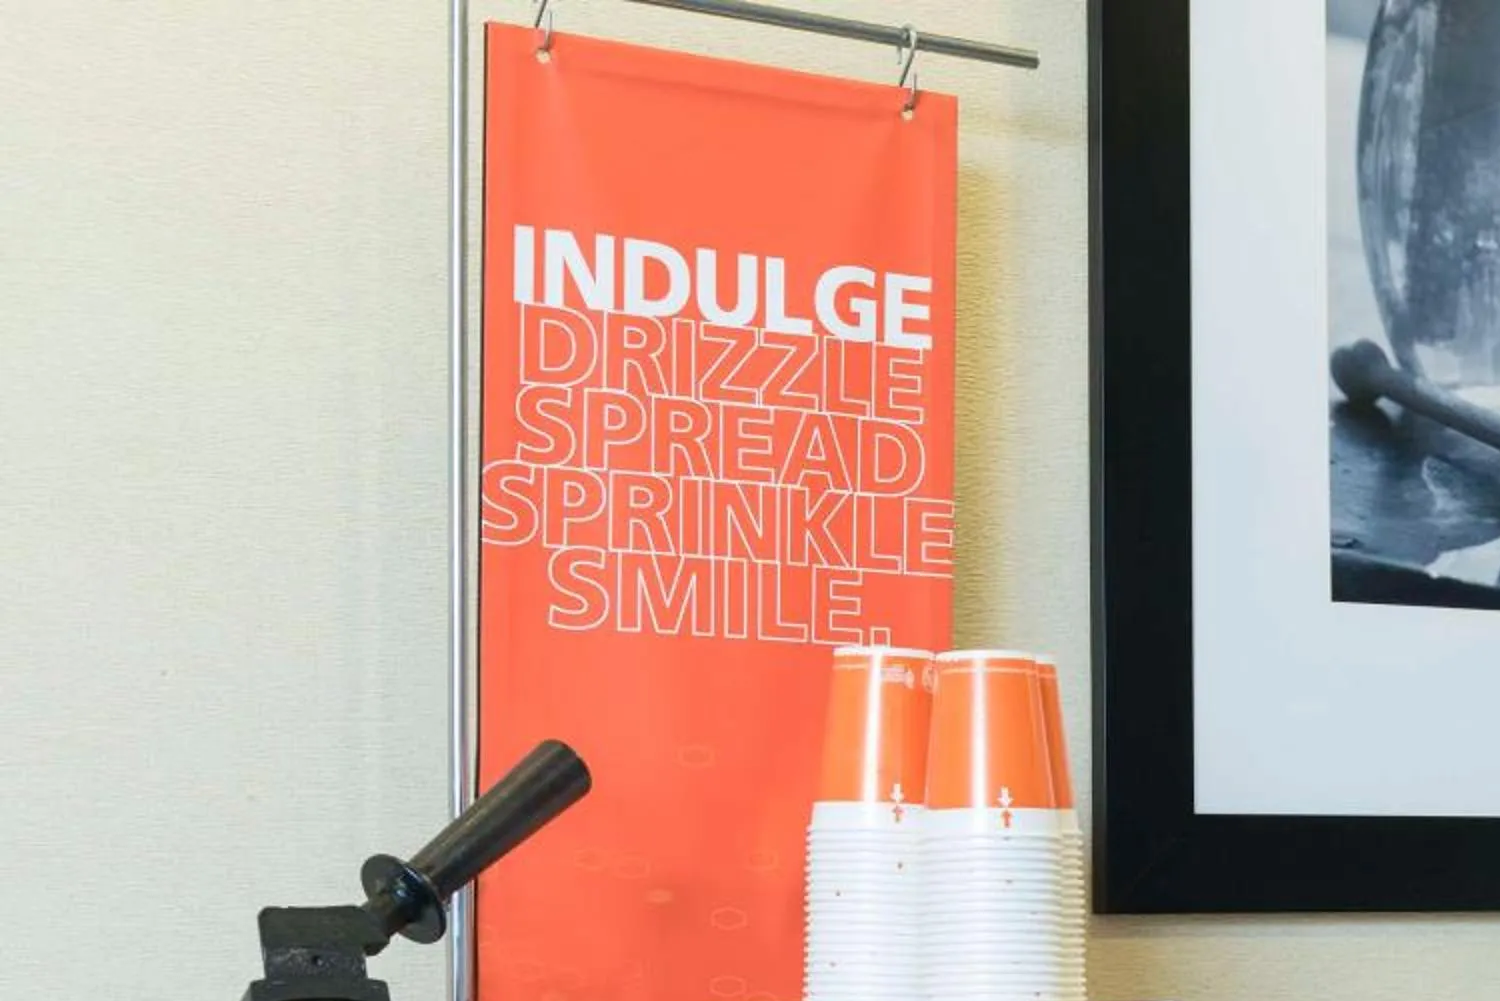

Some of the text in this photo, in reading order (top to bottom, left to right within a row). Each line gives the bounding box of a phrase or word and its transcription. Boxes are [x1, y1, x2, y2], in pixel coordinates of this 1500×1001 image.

[513, 224, 933, 350] INDULGE
[519, 302, 924, 424] DRIZZLE
[515, 384, 926, 497] SPREAD
[481, 460, 954, 578] SPRINKLE
[548, 546, 891, 648] SMILE.
